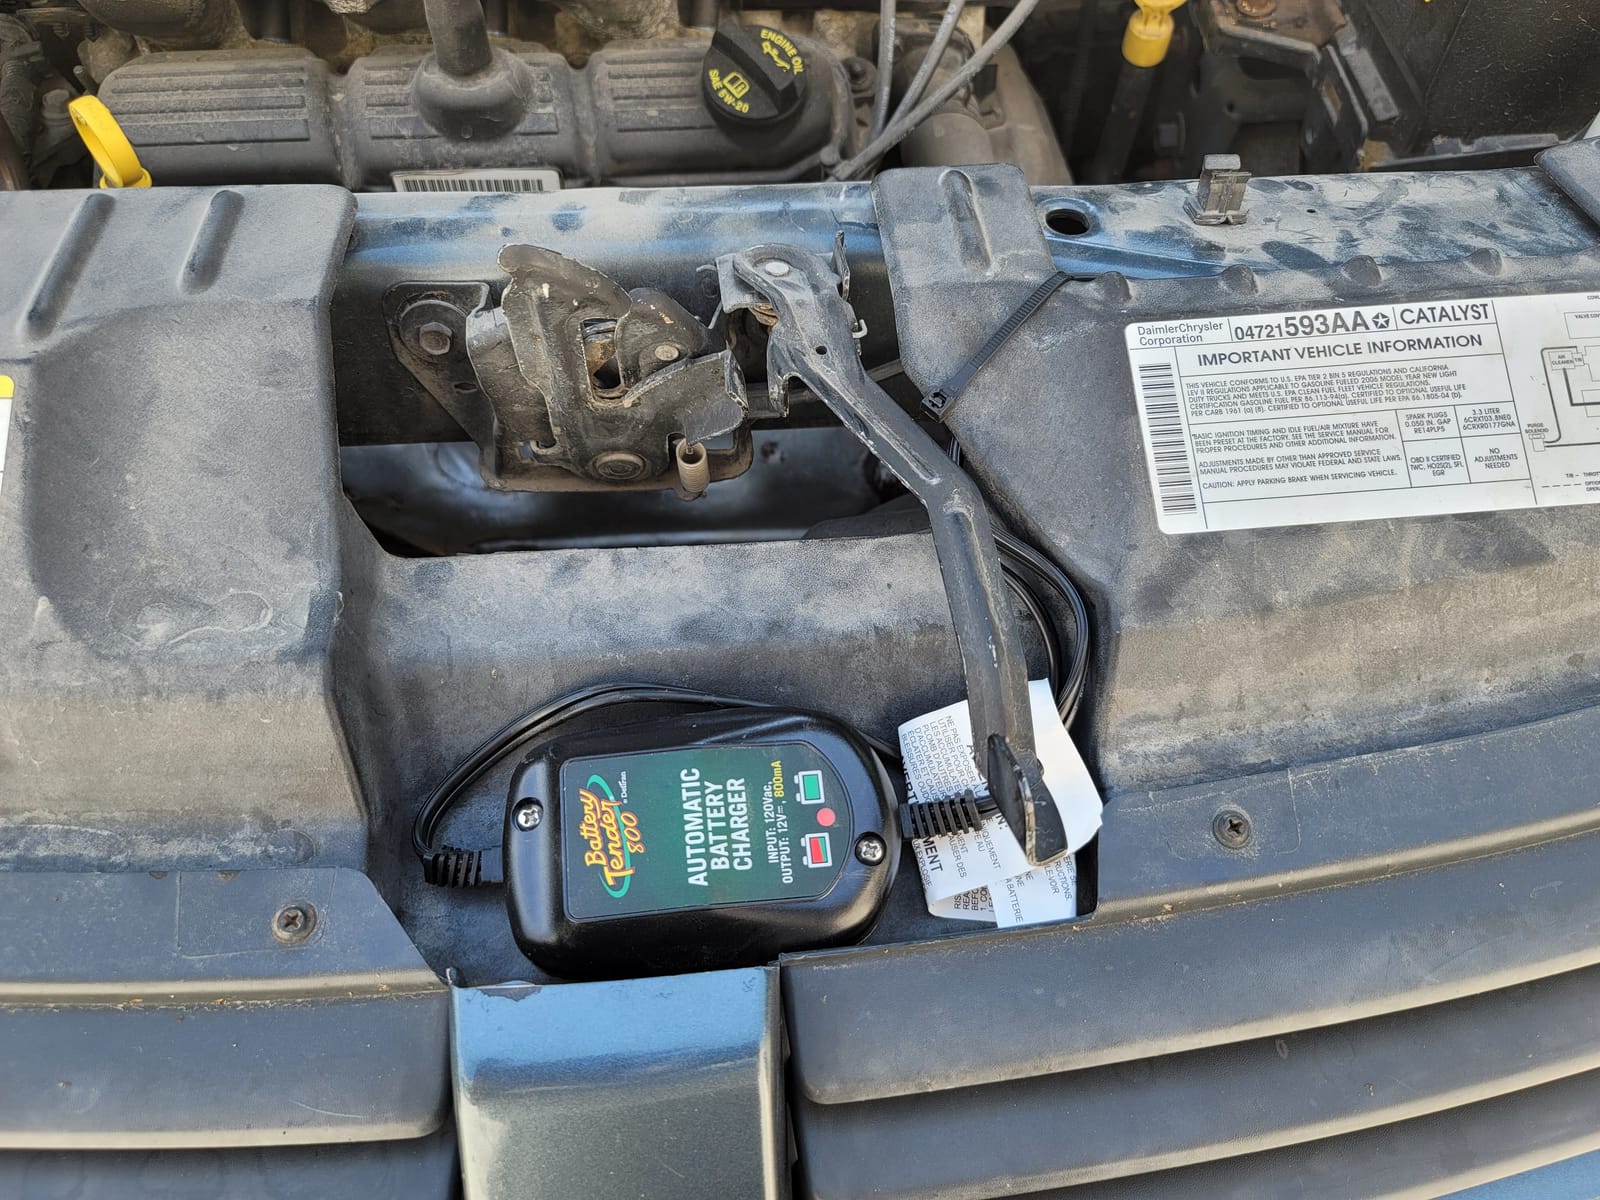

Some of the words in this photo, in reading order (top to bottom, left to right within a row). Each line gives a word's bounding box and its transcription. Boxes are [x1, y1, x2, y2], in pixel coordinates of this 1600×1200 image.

[760, 28, 797, 57] ENGINE
[791, 55, 803, 75] OIL
[708, 69, 723, 90] SAE
[717, 88, 750, 113] 5W-20
[1400, 303, 1489, 325] CATALYST
[1138, 321, 1223, 335] DaimlerChrysler
[1140, 334, 1202, 346] Corporation
[1197, 348, 1292, 366] IMPORTANT
[1294, 342, 1362, 359] VEHICLE
[1367, 334, 1483, 354] INFORMATION
[1200, 380, 1227, 388] VEHICLE
[1229, 377, 1269, 386] CONFORMS
[1347, 368, 1391, 377] REGULATIONS
[1409, 364, 1448, 373] CALIFORNIA
[1205, 385, 1250, 394] REGULATIONS
[1251, 383, 1288, 391] APPLICABLE
[1301, 379, 1334, 387] GASOLINE
[1379, 374, 1403, 382] MODEL
[1439, 370, 1457, 378] LIGHT
[1297, 387, 1320, 395] CLEAN
[1385, 379, 1430, 388] REGULATIONS.
[1189, 400, 1237, 409] CERTIFICATION
[1239, 398, 1272, 406] GASOLINE
[1351, 390, 1383, 398] CERTIFIED
[1395, 387, 1427, 395] OPTIONAL
[1267, 403, 1299, 411] CERTIFIED
[1311, 400, 1344, 408] OPTIONAL
[1345, 398, 1368, 406] USEFUL
[1223, 442, 1267, 451] PROCEDURES
[1307, 437, 1346, 445] ADDITIONAL
[1348, 433, 1396, 442] INFORMATION.
[1198, 458, 1243, 468] ADJUSTMENTS
[1275, 454, 1297, 462] OTHER
[1317, 450, 1352, 459] APPROVED
[1353, 448, 1381, 456] SERVICE
[1229, 463, 1273, 472] PROCEDURES
[1290, 460, 1316, 468] VIOLATE
[1317, 458, 1345, 466] FEDERAL
[1430, 453, 1460, 461] CERTIFIED
[1473, 453, 1518, 462] ADJUSTMENTS
[1201, 481, 1234, 489] CAUTION:
[1257, 477, 1285, 485] PARKING
[1330, 471, 1366, 479] SERVICING
[1368, 469, 1397, 477] VEHICLE.
[922, 723, 938, 752] PLOMB
[930, 722, 940, 737] LES
[901, 733, 921, 780] BLESSURES
[938, 718, 956, 755] UTILISER
[951, 755, 965, 777] POUR
[946, 715, 955, 727] NE
[951, 728, 961, 746] PAS
[957, 745, 976, 782] EXPOSER
[771, 760, 784, 798] 800mA
[920, 766, 929, 777] ET
[763, 782, 775, 823] 120Vac,
[579, 788, 608, 867] Battery
[620, 811, 645, 854] 800
[680, 768, 708, 886] AUTOMATIC
[704, 781, 730, 870] BATTERY
[727, 778, 752, 870] CHARGER
[600, 799, 635, 885] Tender
[766, 826, 779, 863] INPUT:
[779, 837, 793, 883] OUTPUT:
[957, 861, 967, 878] DES
